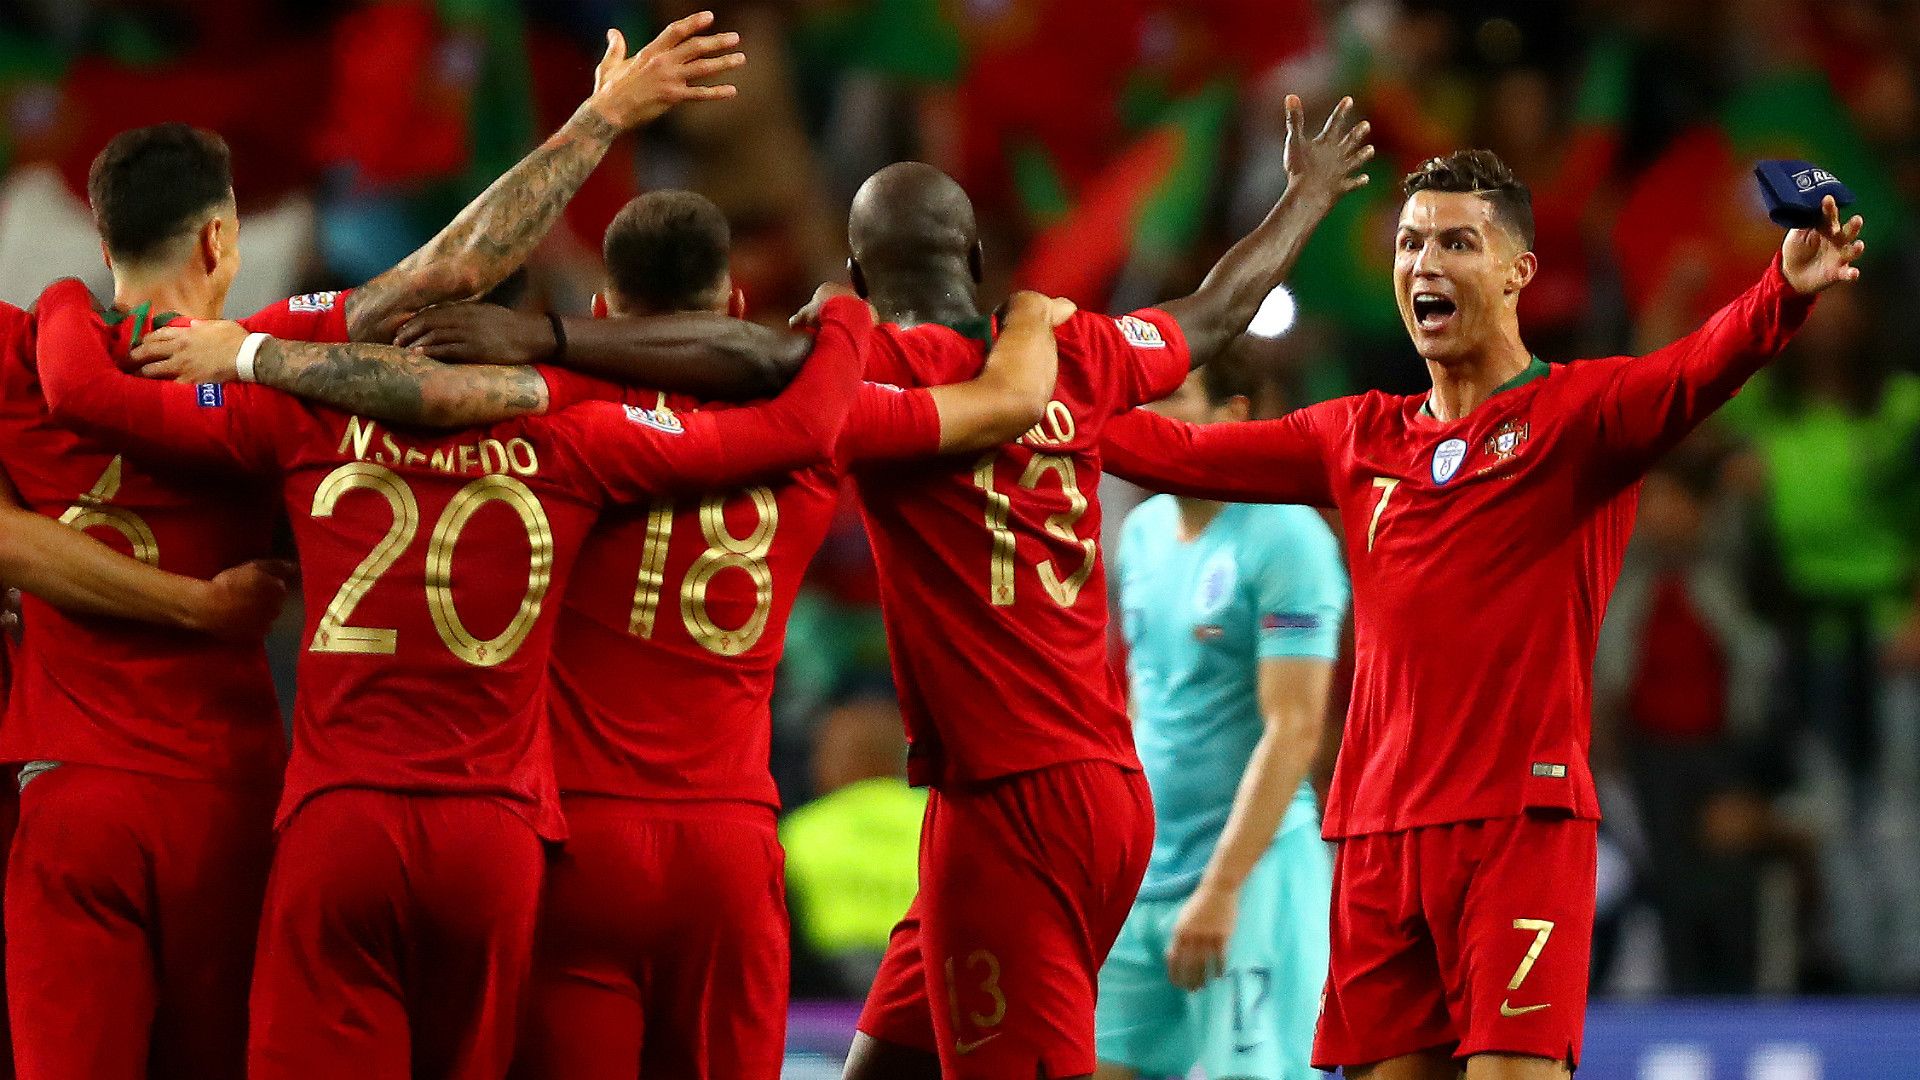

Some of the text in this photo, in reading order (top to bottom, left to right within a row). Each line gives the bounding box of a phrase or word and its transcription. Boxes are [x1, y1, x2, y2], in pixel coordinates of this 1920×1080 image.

[974, 452, 1097, 607] 13
[1367, 476, 1401, 553] 7
[309, 462, 554, 667] 20
[628, 486, 779, 657] 18
[943, 949, 1008, 1031] 13
[1507, 918, 1555, 990] 7
[1223, 966, 1274, 1032] 17
